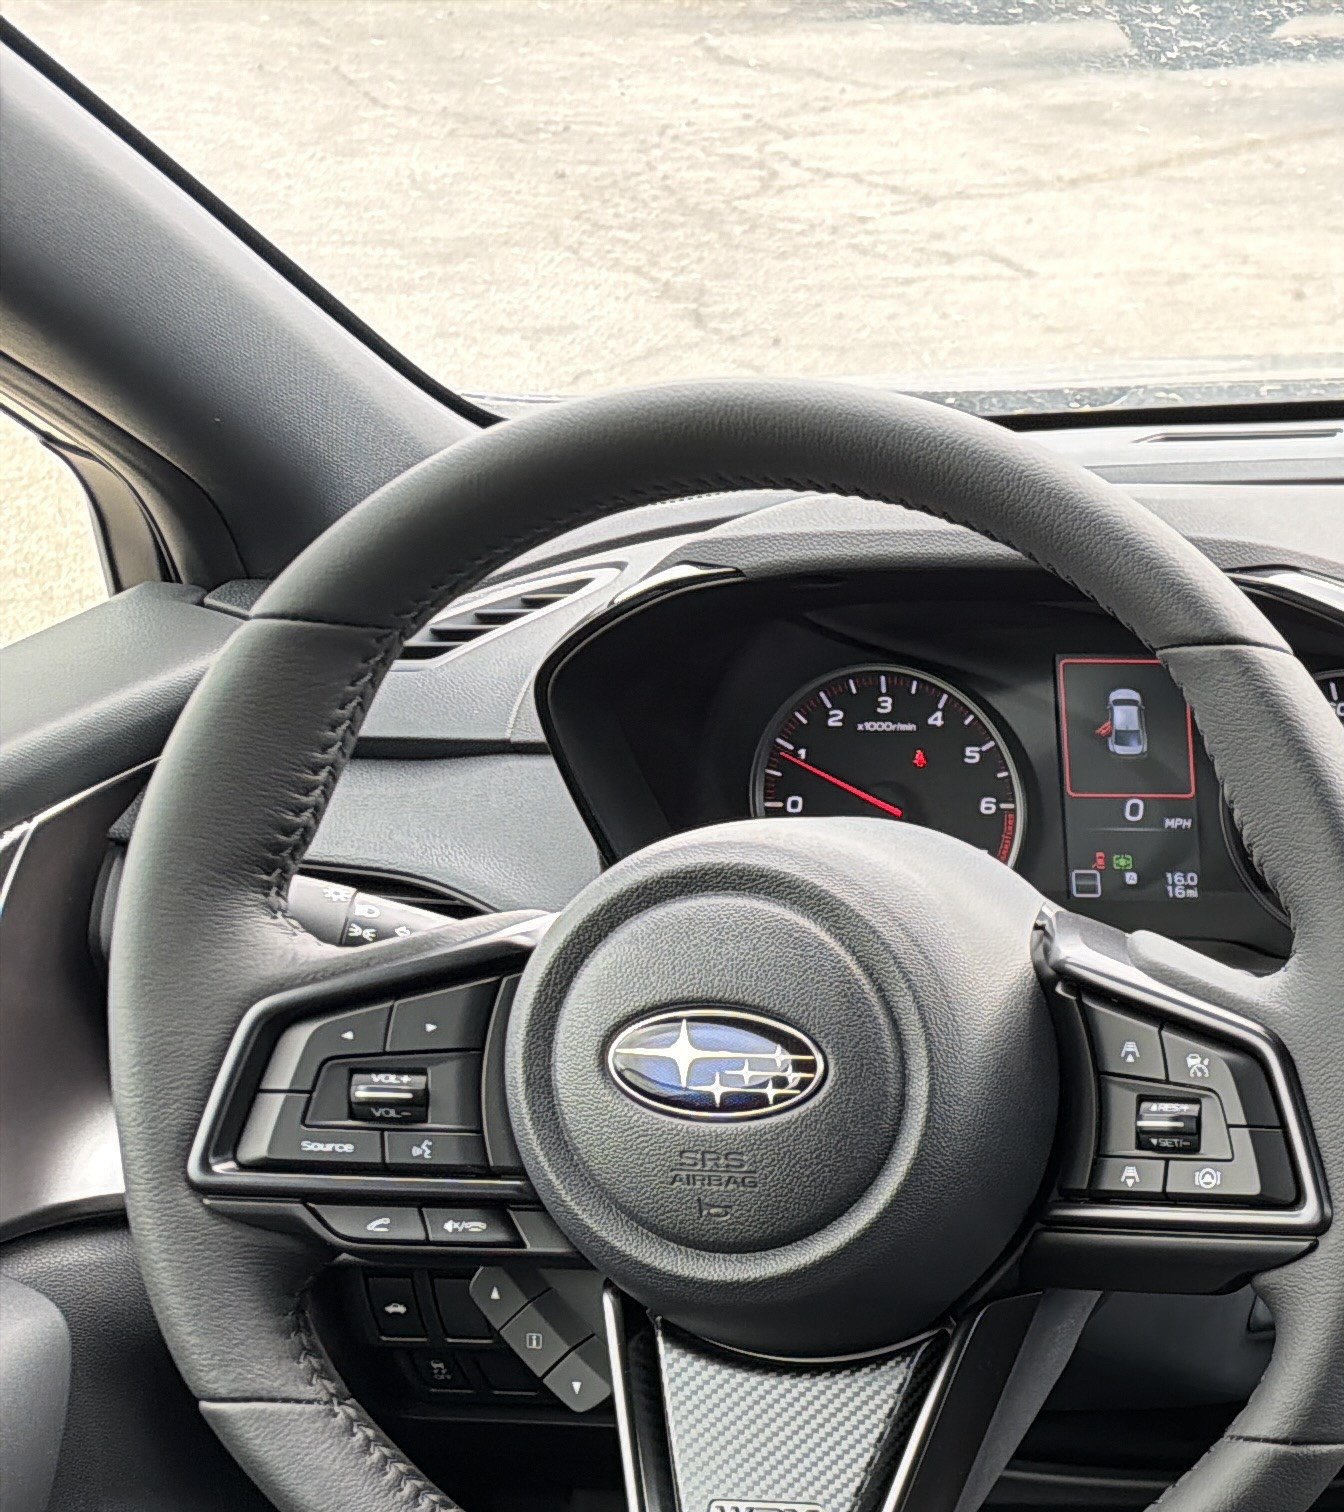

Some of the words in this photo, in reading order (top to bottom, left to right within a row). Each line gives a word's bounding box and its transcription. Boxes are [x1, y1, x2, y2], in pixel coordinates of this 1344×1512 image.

[876, 696, 893, 714] 3
[826, 710, 844, 727] 2
[927, 710, 945, 727] 4
[797, 748, 807, 760] 1
[963, 746, 981, 764] 5
[786, 796, 803, 813] 0
[979, 797, 997, 815] 6
[1124, 798, 1144, 822] 0
[1164, 818, 1192, 830] MPH
[1166, 872, 1198, 886] 16.0
[301, 1140, 355, 1154] Source
[669, 1173, 758, 1189] AIRBAG
